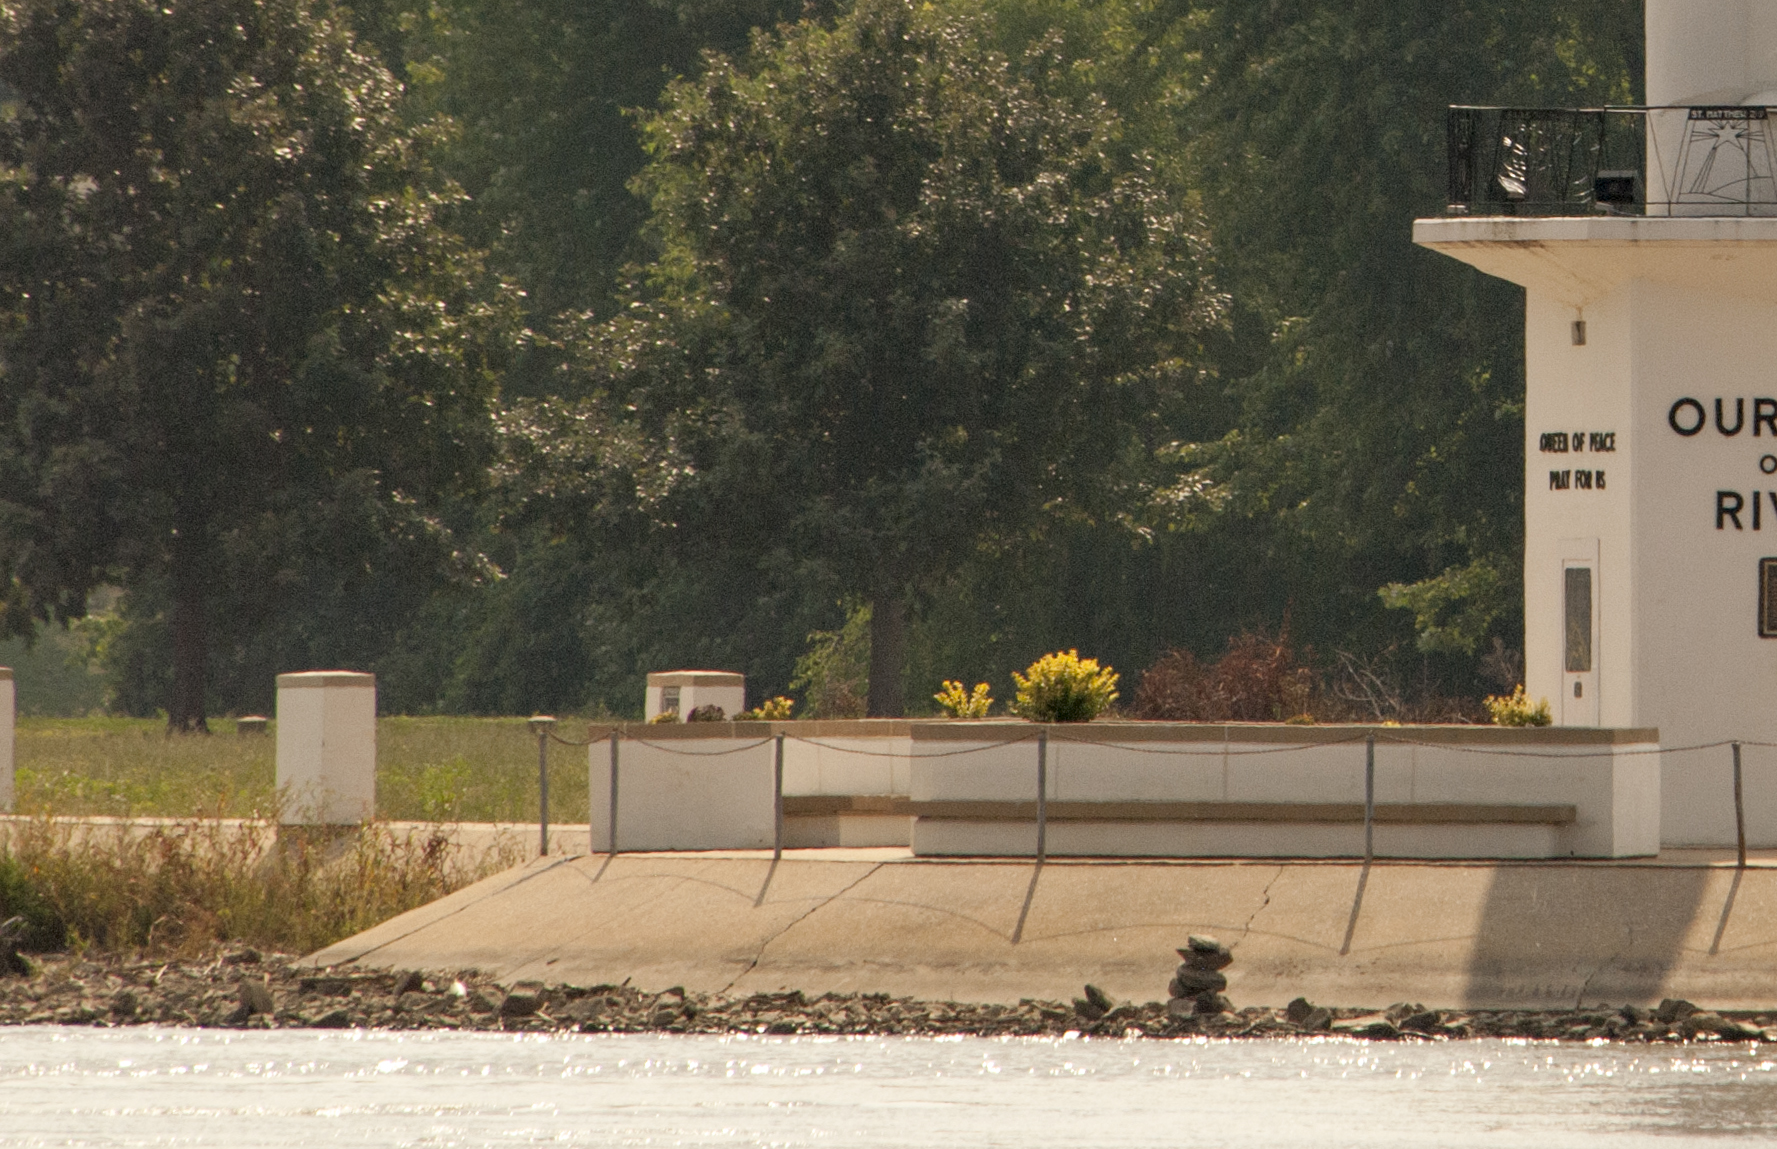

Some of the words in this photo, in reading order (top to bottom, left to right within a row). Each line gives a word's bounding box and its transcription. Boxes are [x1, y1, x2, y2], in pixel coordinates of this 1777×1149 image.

[1538, 431, 1569, 454] QUEEN
[1572, 432, 1586, 453] OF
[1589, 432, 1616, 453] PEACE
[1549, 469, 1571, 491] PRAY
[1574, 469, 1593, 490] FOR
[1595, 470, 1606, 490] US
